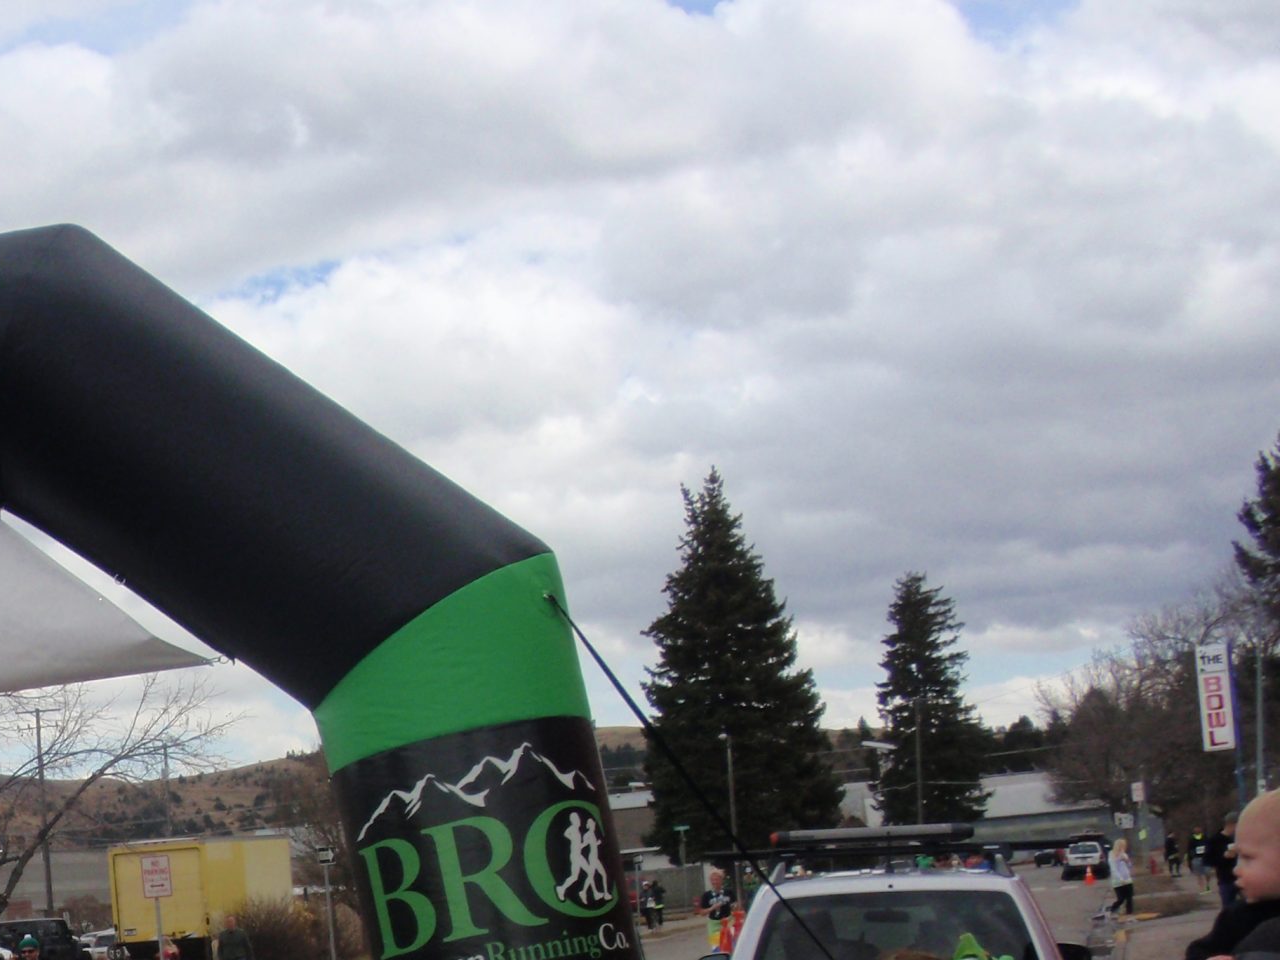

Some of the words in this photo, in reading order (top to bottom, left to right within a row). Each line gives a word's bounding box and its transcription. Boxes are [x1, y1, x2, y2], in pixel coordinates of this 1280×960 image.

[1200, 654, 1223, 665] THE
[1203, 675, 1229, 747] BOWL
[358, 799, 619, 960] BRC
